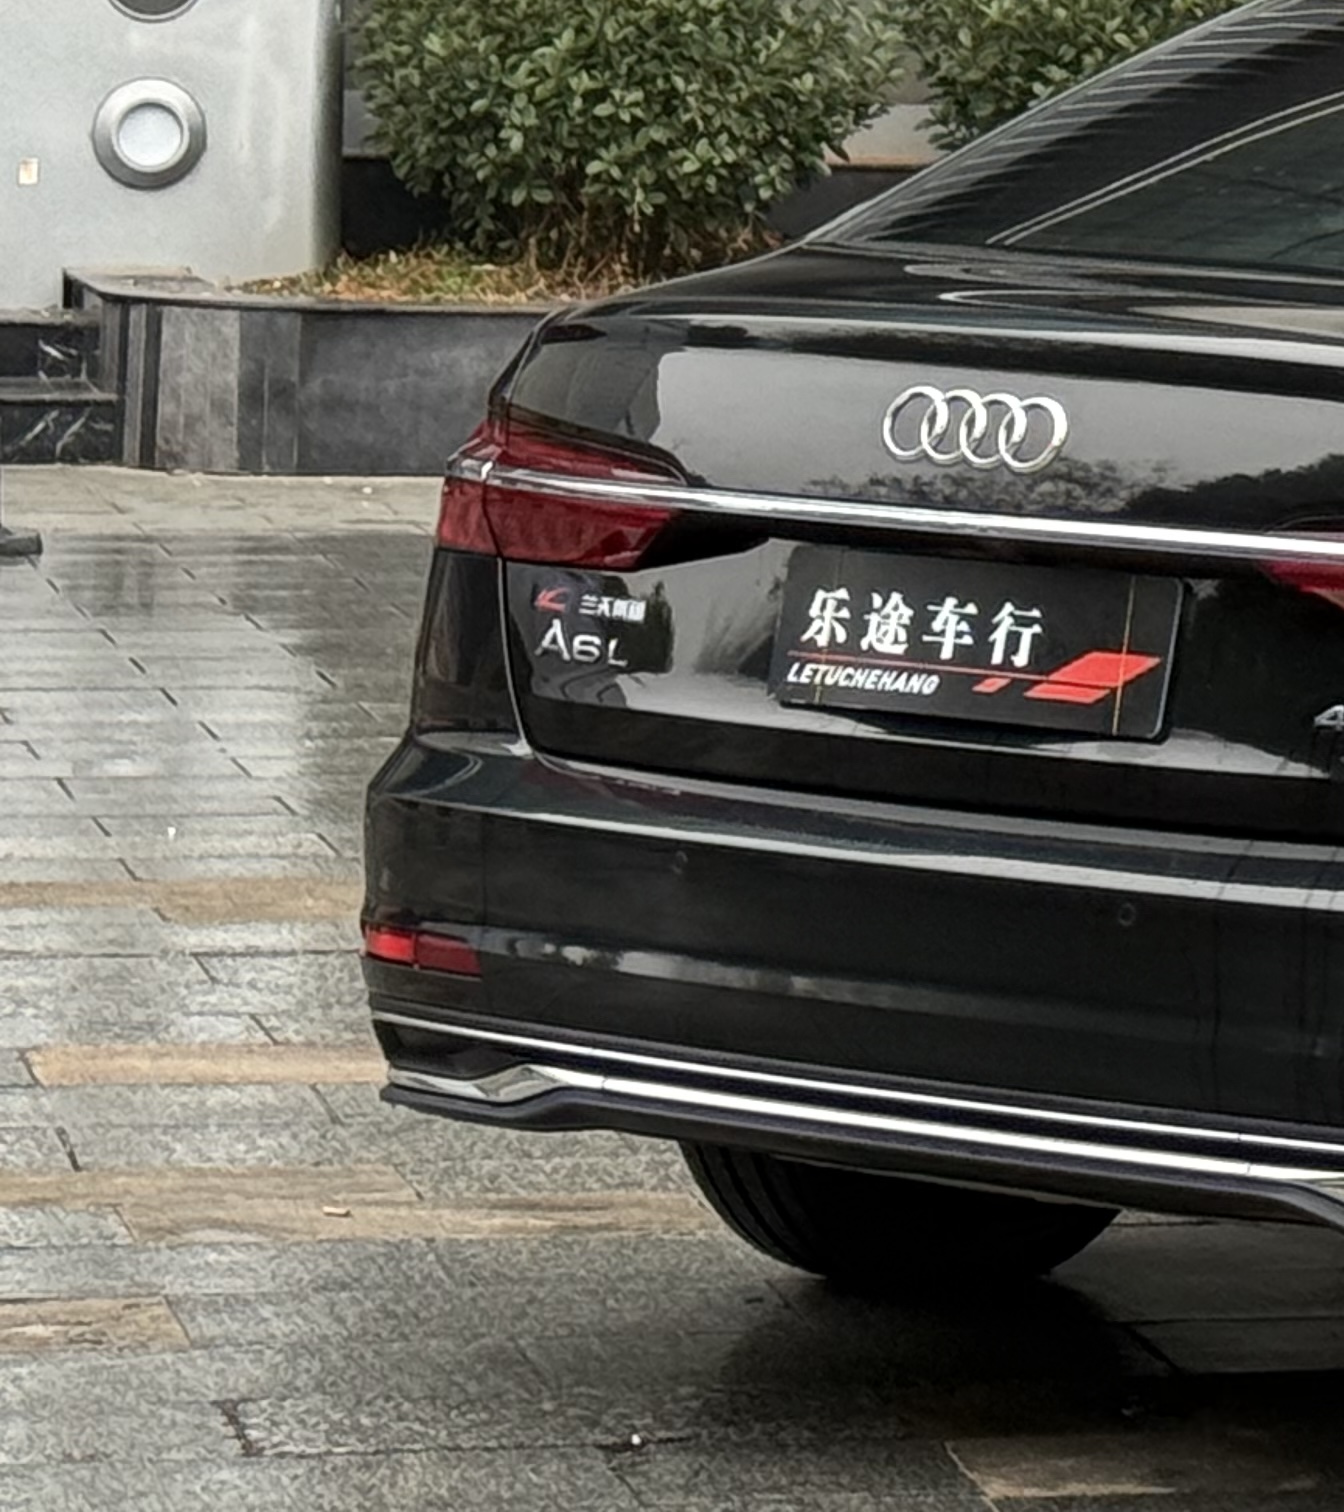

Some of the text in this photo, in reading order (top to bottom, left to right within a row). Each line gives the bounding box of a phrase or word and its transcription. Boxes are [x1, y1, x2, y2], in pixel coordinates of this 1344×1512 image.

[534, 618, 628, 667] A6L
[801, 587, 1043, 668] 乐途车行
[787, 661, 940, 696] LETUCHEHANG
